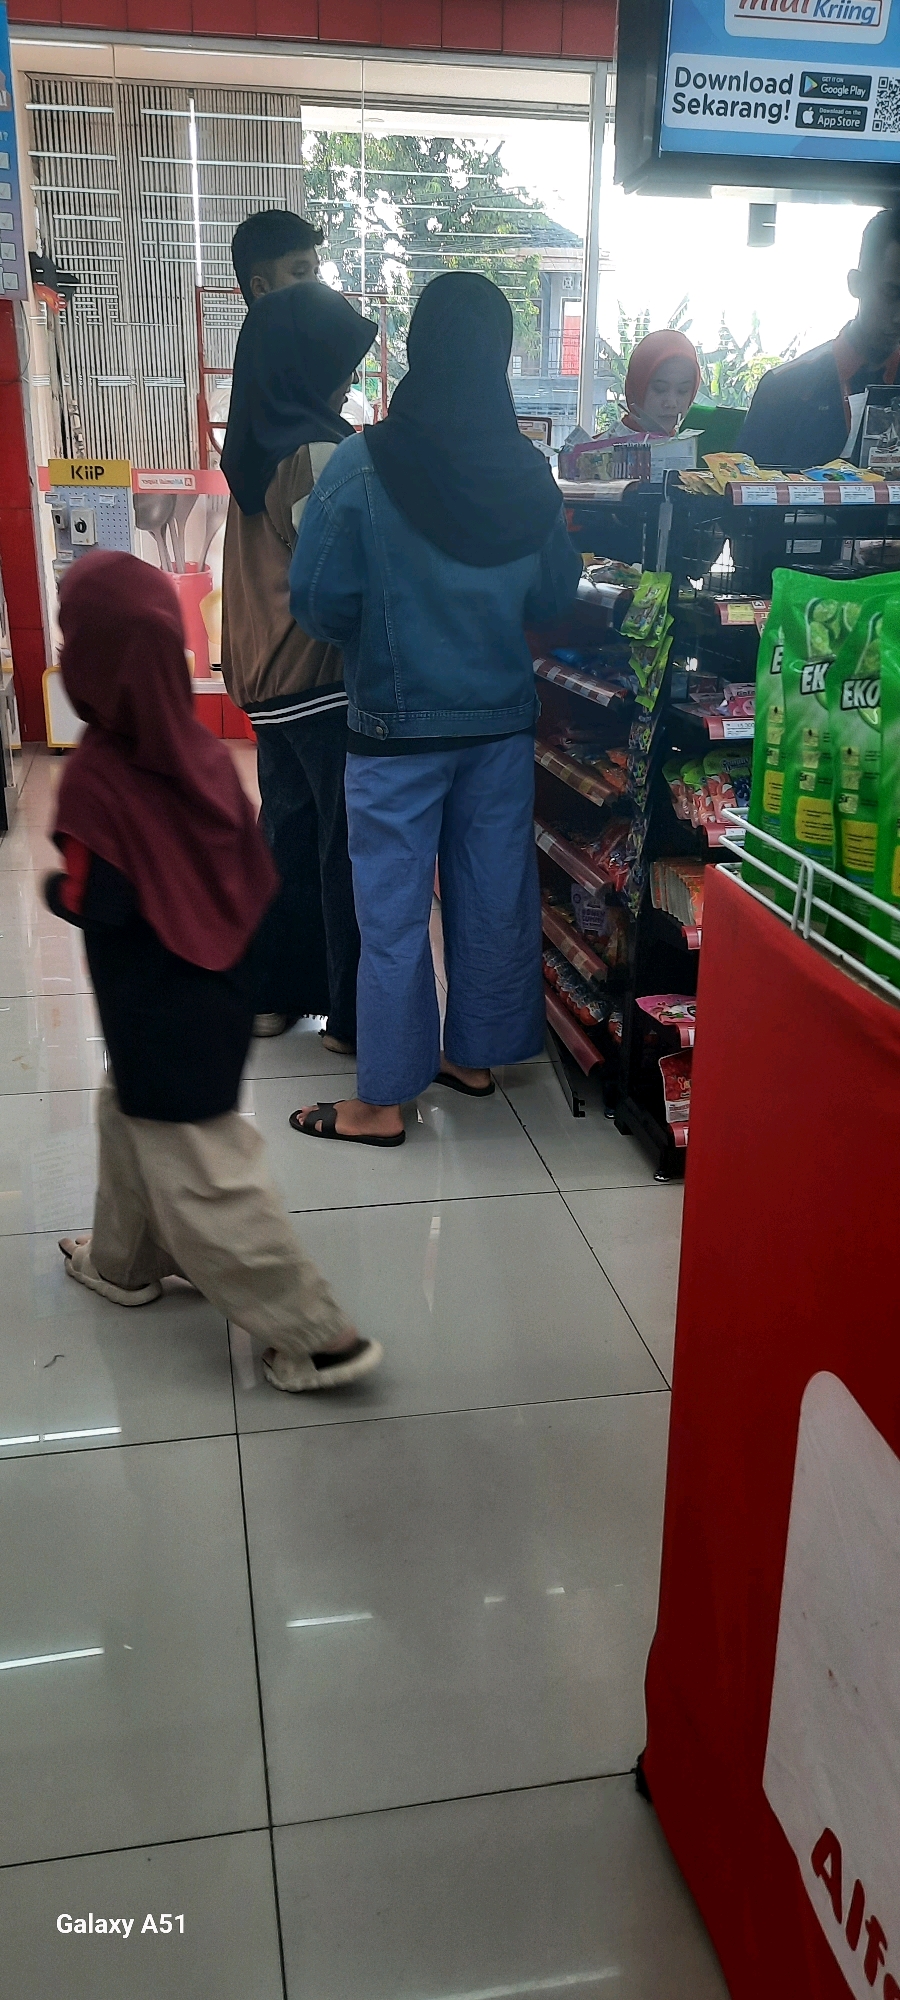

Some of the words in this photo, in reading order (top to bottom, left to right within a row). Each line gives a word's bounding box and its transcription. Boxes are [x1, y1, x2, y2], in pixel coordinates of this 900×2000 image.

[813, 0, 876, 25] Kriing
[675, 66, 794, 95] Download
[821, 83, 849, 97] Google
[850, 85, 866, 98] Play
[671, 92, 791, 124] Sekarang!
[819, 107, 845, 115] Download
[817, 114, 837, 128] App
[837, 116, 861, 128] Store
[71, 465, 105, 480] KiiP
